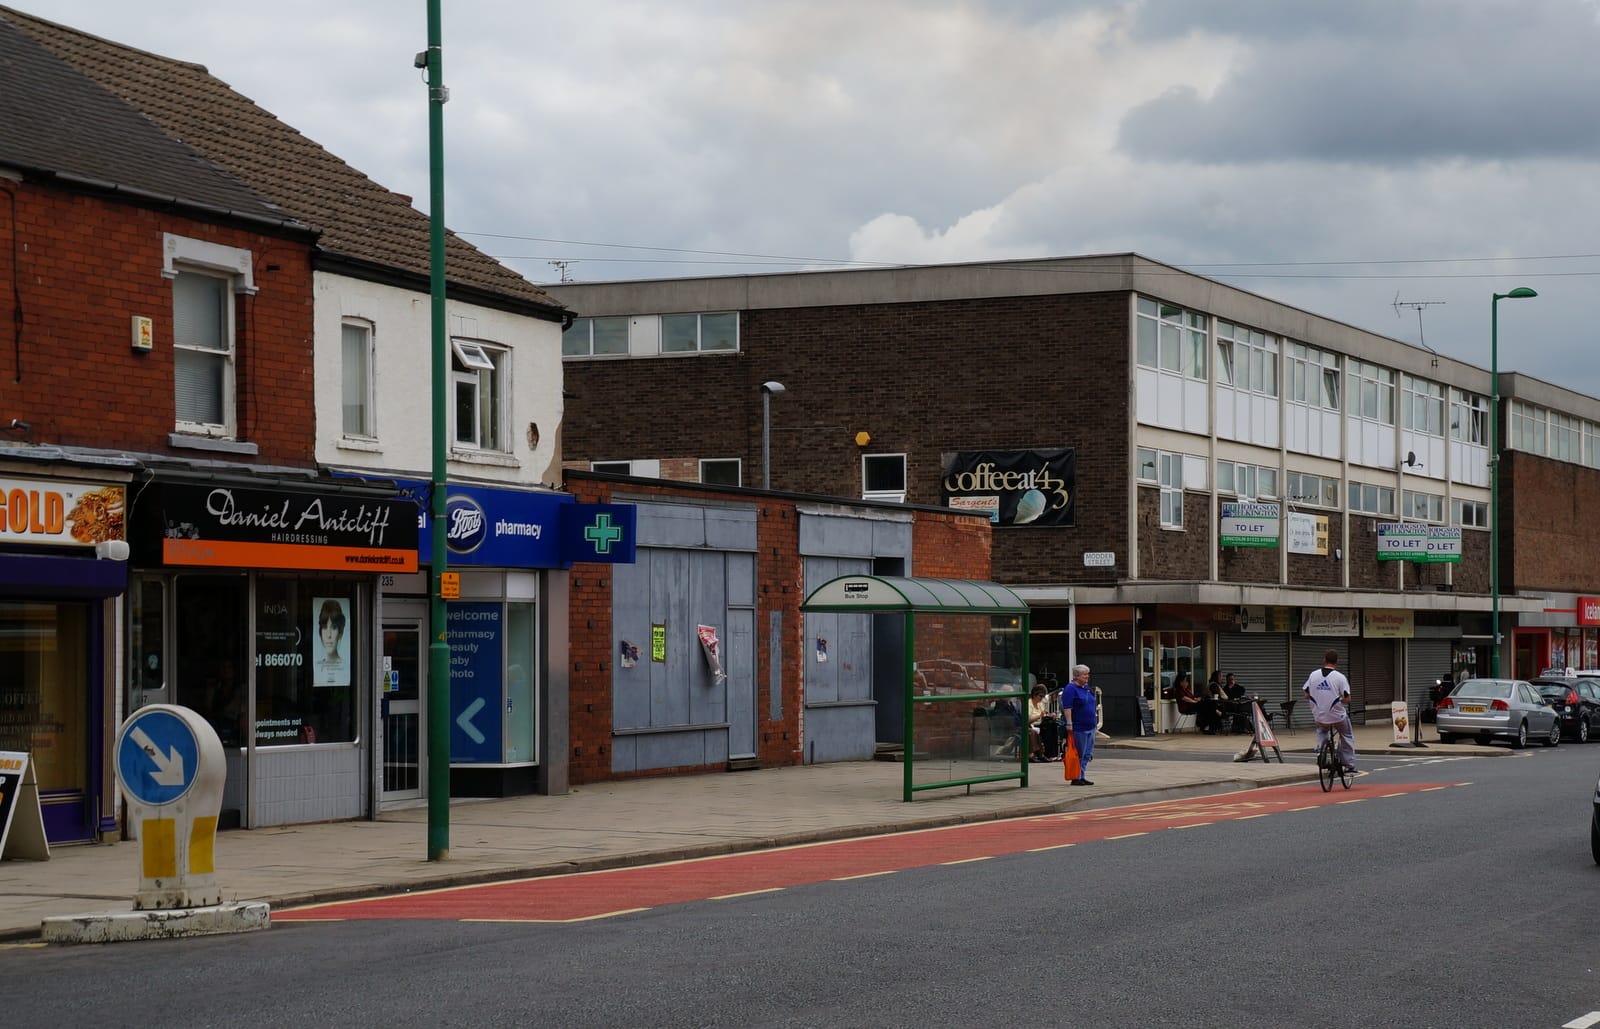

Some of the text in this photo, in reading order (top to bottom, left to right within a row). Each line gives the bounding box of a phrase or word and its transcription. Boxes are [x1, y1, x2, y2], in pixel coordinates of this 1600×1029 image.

[1238, 503, 1278, 511] HODGSON
[206, 488, 390, 546] Daniel Antcliff
[447, 509, 481, 539] Boots
[495, 519, 542, 539] pharmacy
[1235, 524, 1247, 532] TO
[271, 533, 328, 544] HAIRDRESSING
[1403, 540, 1421, 548] LET
[381, 576, 394, 586] 235
[446, 629, 495, 640] pharmacy
[1078, 627, 1118, 640] coffeeat
[449, 642, 479, 653] eauty
[264, 653, 303, 667] 866070
[449, 656, 470, 666] aby
[449, 669, 474, 679] hoto
[255, 718, 302, 728] pointments not
[276, 729, 298, 737] needed
